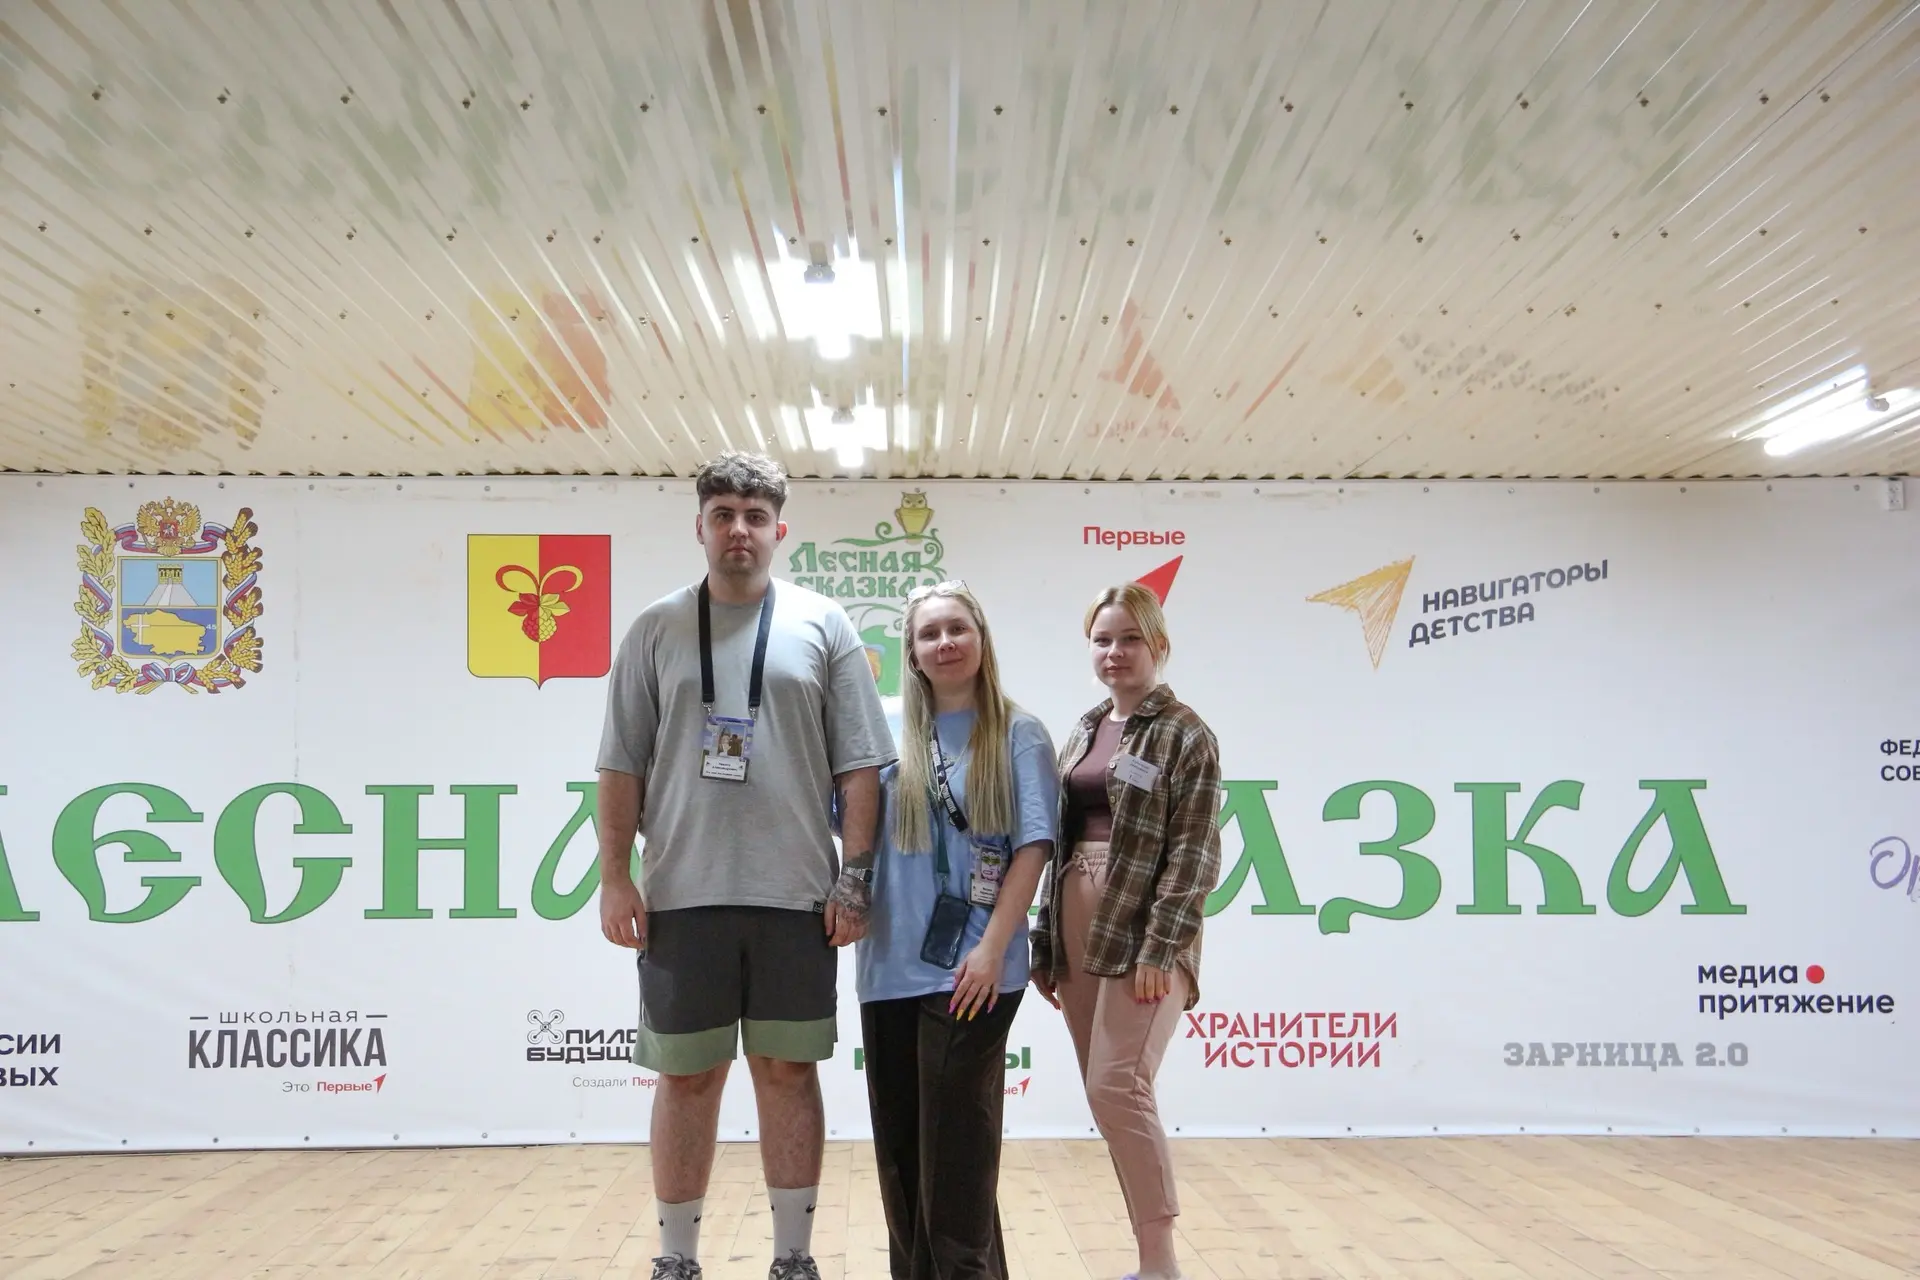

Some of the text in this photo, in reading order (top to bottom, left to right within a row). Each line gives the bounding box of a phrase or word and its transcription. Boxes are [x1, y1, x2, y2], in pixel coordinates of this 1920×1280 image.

[1083, 526, 1186, 551] Первые
[1422, 559, 1608, 614] НАВИГАТОРЫ
[1408, 602, 1535, 648] ДЕТСТВА
[1204, 779, 1747, 934] АЗКА
[1698, 964, 1798, 988] медиа
[219, 1010, 358, 1024] школьная
[1698, 994, 1895, 1020] притяжение
[1186, 1012, 1397, 1038] ХРАНИТЕЛИ
[189, 1028, 387, 1069] КЛАССИКА
[527, 1046, 633, 1064] БУДУЩ
[1204, 1041, 1381, 1068] ИСТОРИИ
[1503, 1042, 1749, 1072] ЗАРНИЦА 2.0
[282, 1081, 373, 1094] Это Первые
[572, 1076, 627, 1089] Создали
